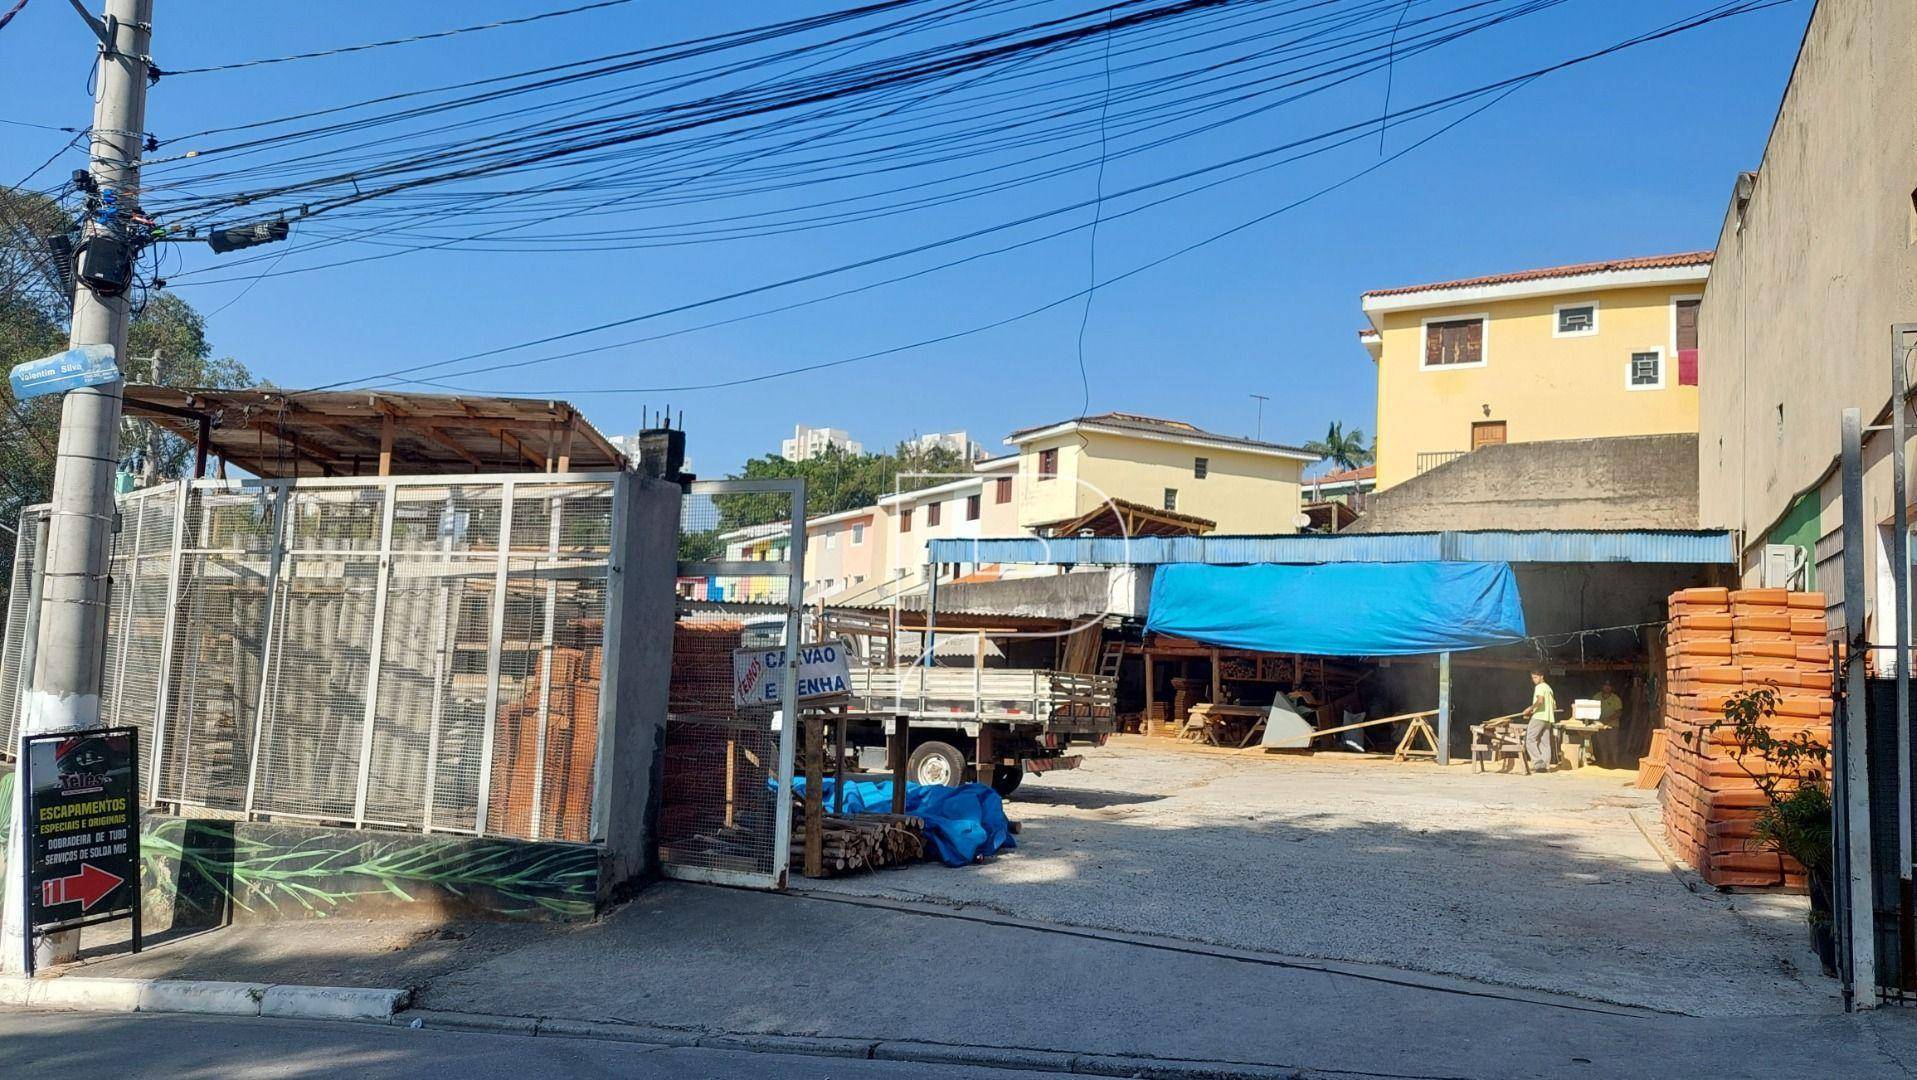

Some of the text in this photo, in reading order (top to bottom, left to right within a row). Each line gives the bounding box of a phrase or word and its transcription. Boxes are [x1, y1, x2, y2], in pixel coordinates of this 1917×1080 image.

[60, 363, 82, 374] Silva
[765, 647, 836, 669] CAVAO
[765, 675, 847, 699] E ENHA
[40, 798, 126, 820] ESCAPAMENTOS
[40, 814, 126, 834] ESPECIAIS E ORIGINAIS
[48, 833, 92, 850] DOBRADEIRA
[95, 831, 105, 843] DE
[109, 829, 127, 841] TUBO
[45, 850, 78, 865] SERVIÇOS
[79, 849, 89, 860] DE
[90, 845, 112, 858] SOLDA
